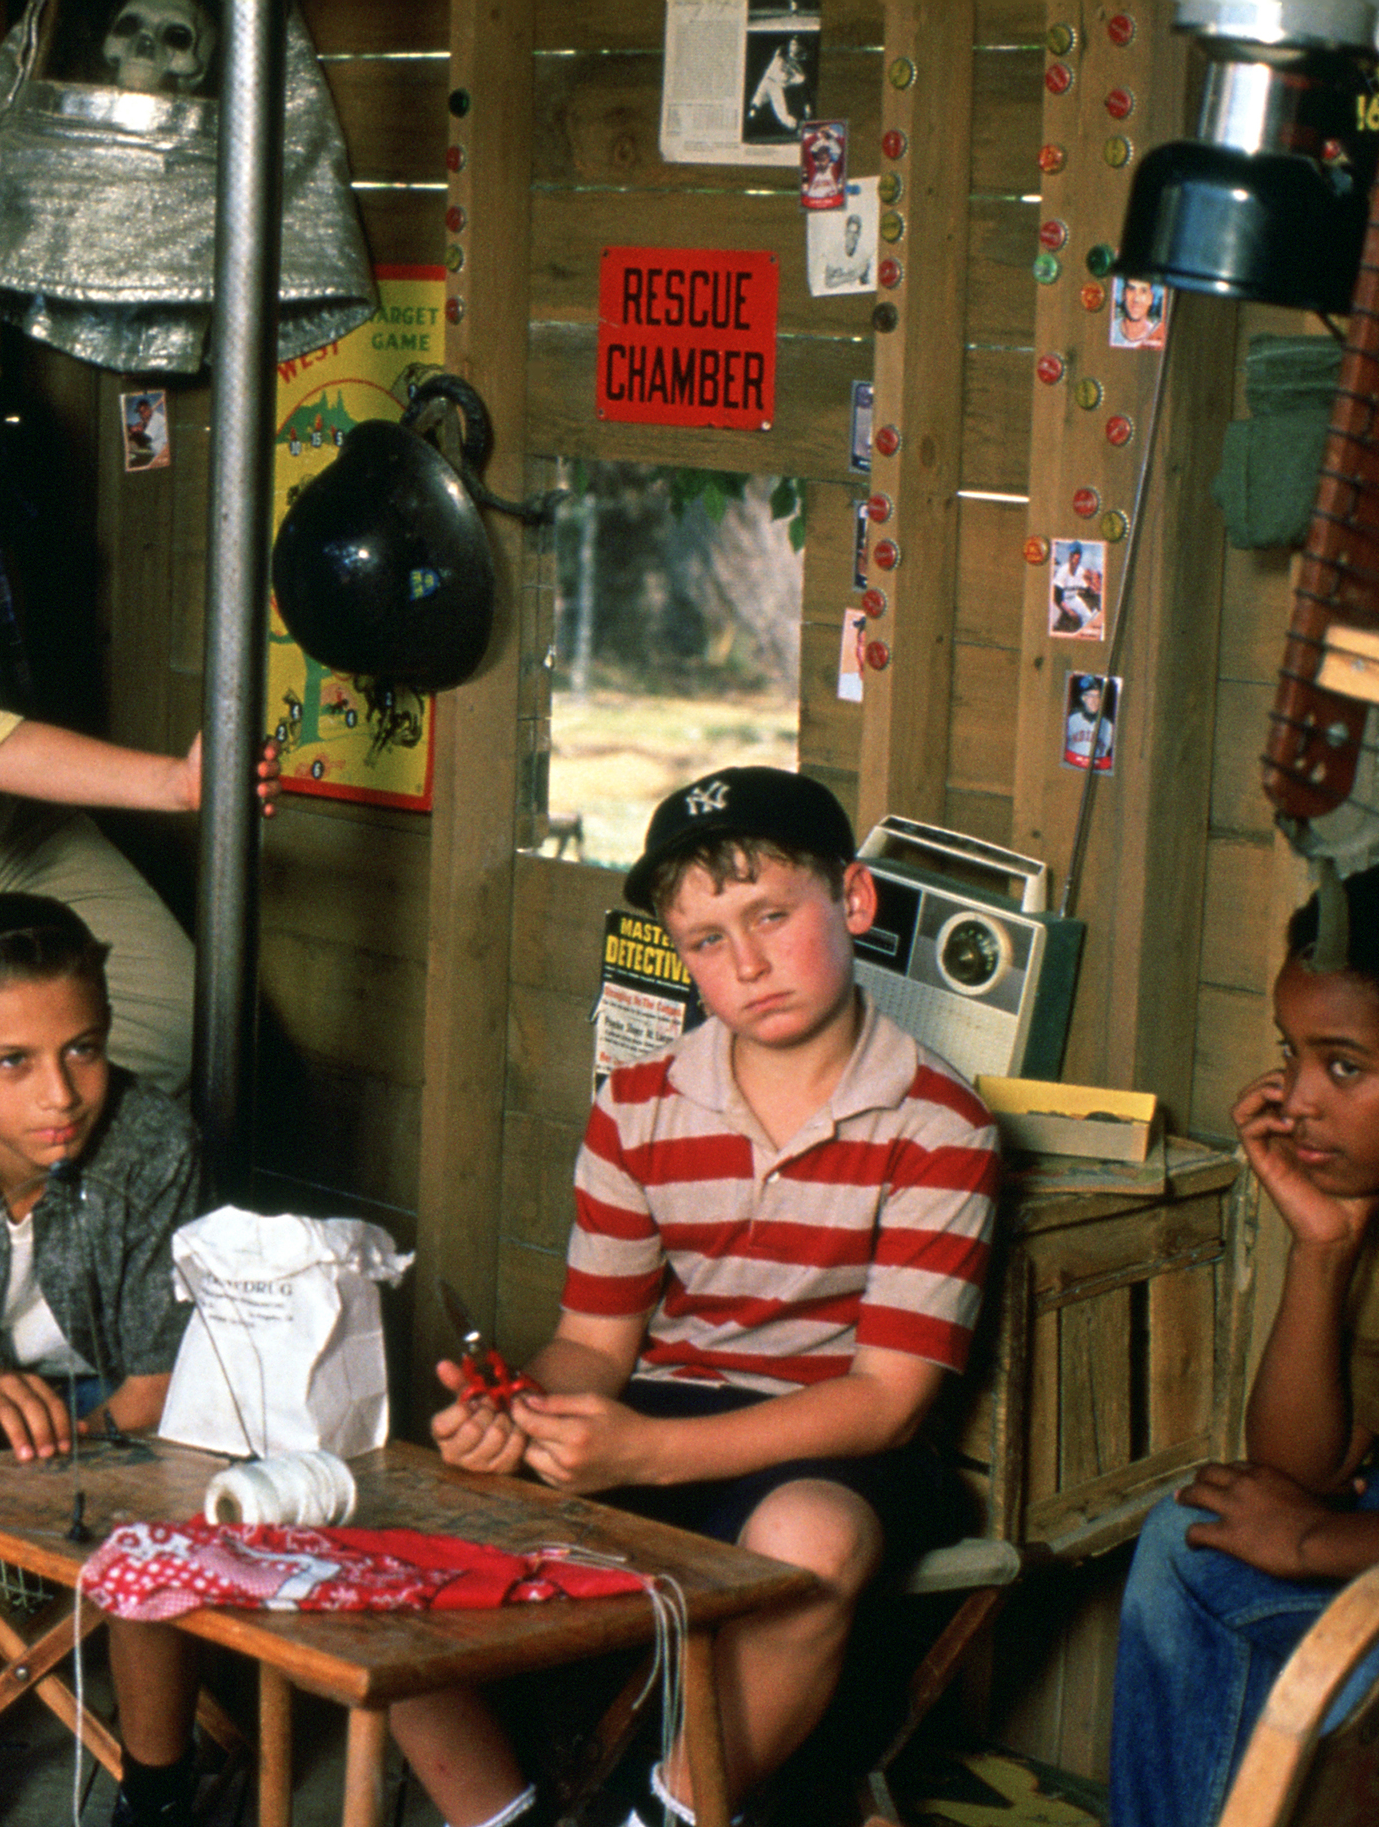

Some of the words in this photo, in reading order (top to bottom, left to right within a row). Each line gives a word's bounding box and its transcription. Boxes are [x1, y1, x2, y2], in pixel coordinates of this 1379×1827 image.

[370, 305, 439, 325] ARGET
[623, 267, 752, 330] RESCUE
[371, 332, 431, 351] GAME
[606, 344, 765, 410] CHAMBER
[685, 781, 730, 815] NY
[620, 917, 675, 948] MASTE
[605, 934, 691, 985] DETECTIVE
